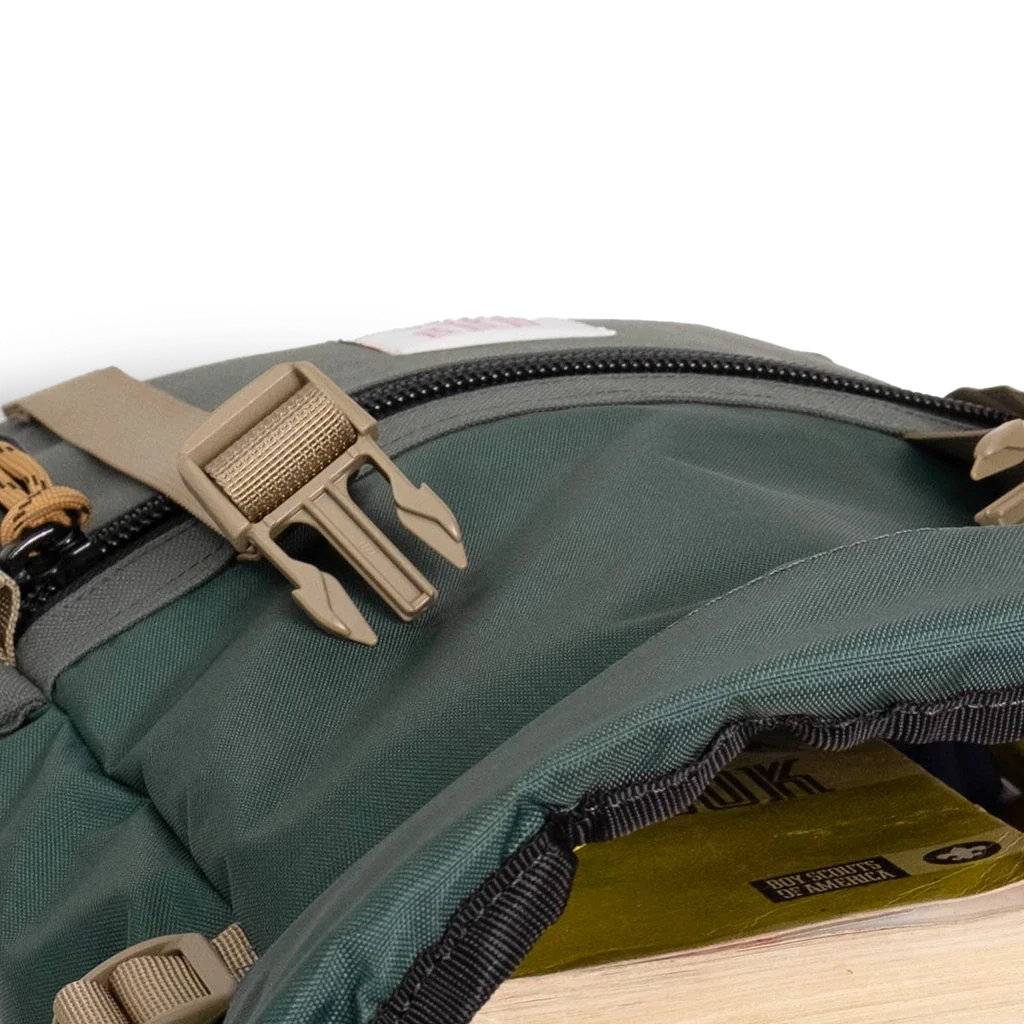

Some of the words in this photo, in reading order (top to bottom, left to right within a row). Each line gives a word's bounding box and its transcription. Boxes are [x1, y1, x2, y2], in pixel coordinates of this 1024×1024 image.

[765, 874, 805, 890] BOY
[806, 860, 882, 881] SCOUTS
[806, 869, 896, 894] AMERICA
